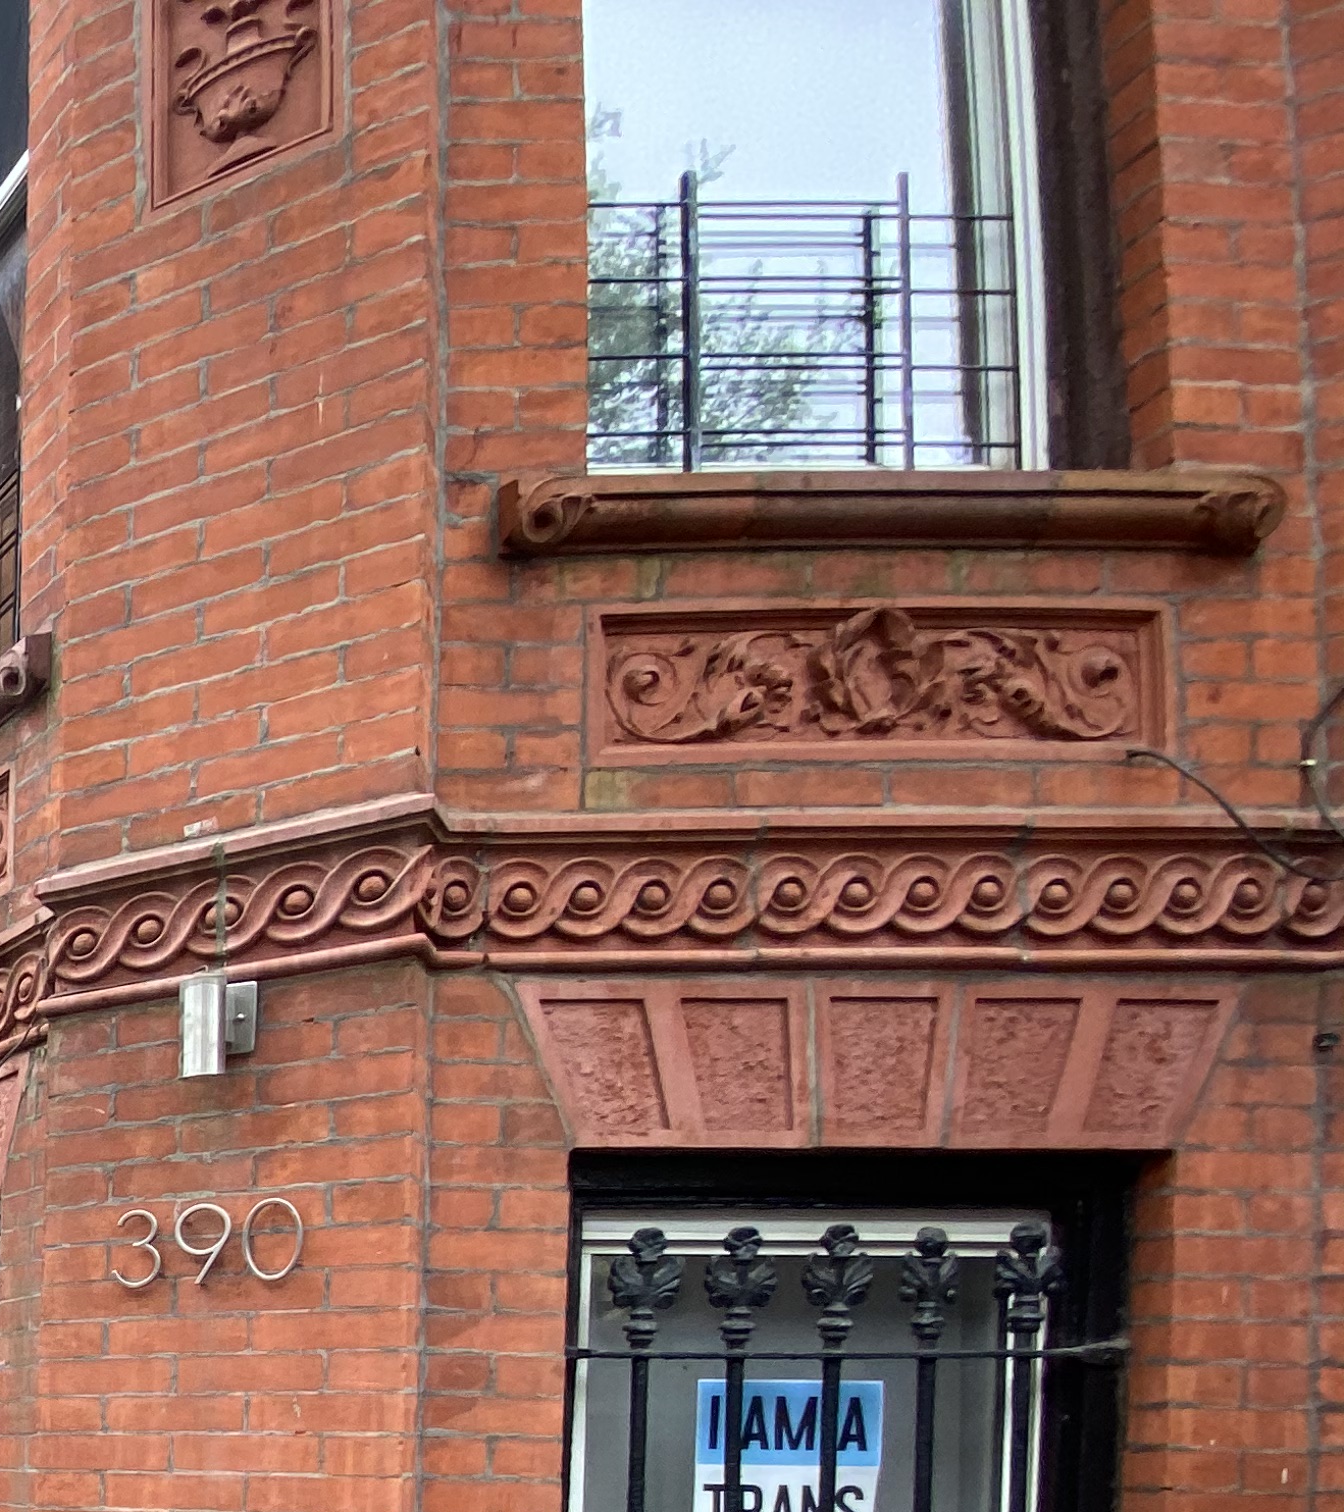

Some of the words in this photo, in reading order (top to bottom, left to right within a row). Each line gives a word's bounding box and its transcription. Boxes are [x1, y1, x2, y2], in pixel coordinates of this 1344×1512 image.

[111, 1197, 304, 1289] 390
[707, 1394, 722, 1451] I
[740, 1395, 820, 1452] AM
[837, 1396, 868, 1452] A
